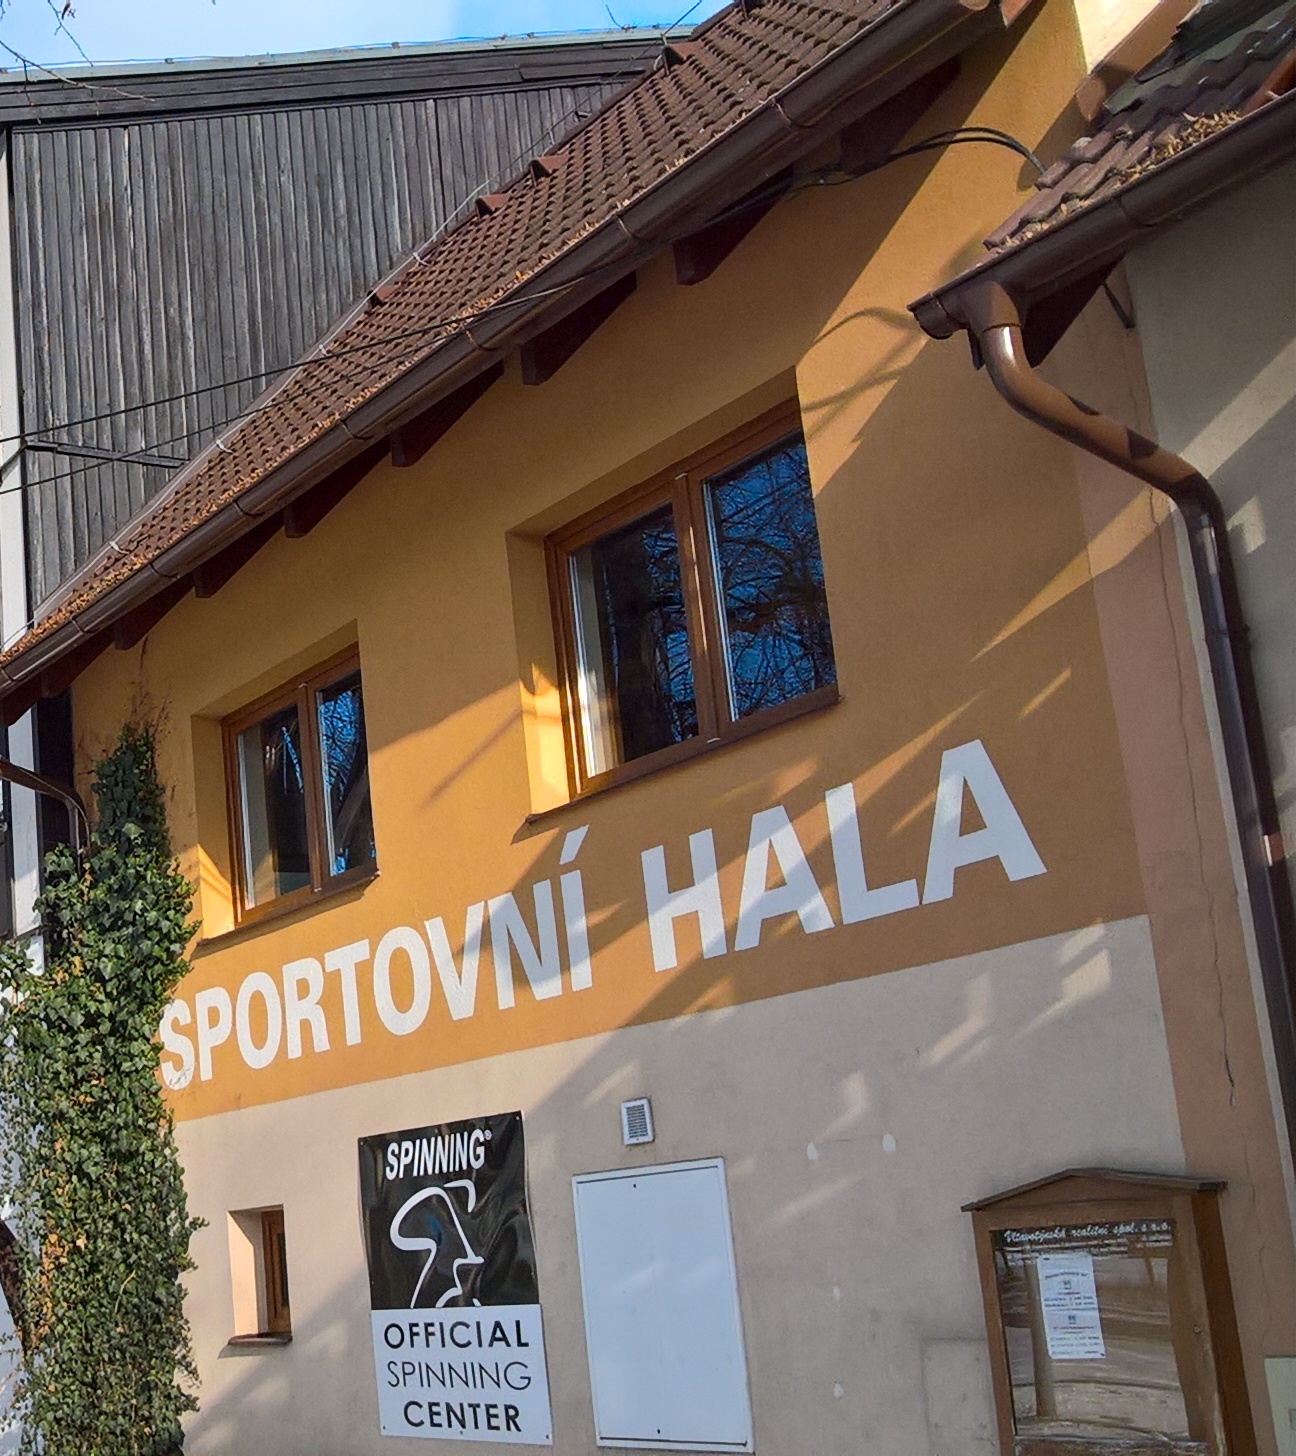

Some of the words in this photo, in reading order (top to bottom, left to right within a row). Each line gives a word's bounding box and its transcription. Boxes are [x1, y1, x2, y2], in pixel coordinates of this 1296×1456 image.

[159, 825, 592, 1090] SPORTOVNÍ
[640, 739, 1048, 973] HALA
[384, 1320, 529, 1349] OFFICIAL
[386, 1361, 532, 1391] SPINNING
[403, 1401, 522, 1433] CENTER
